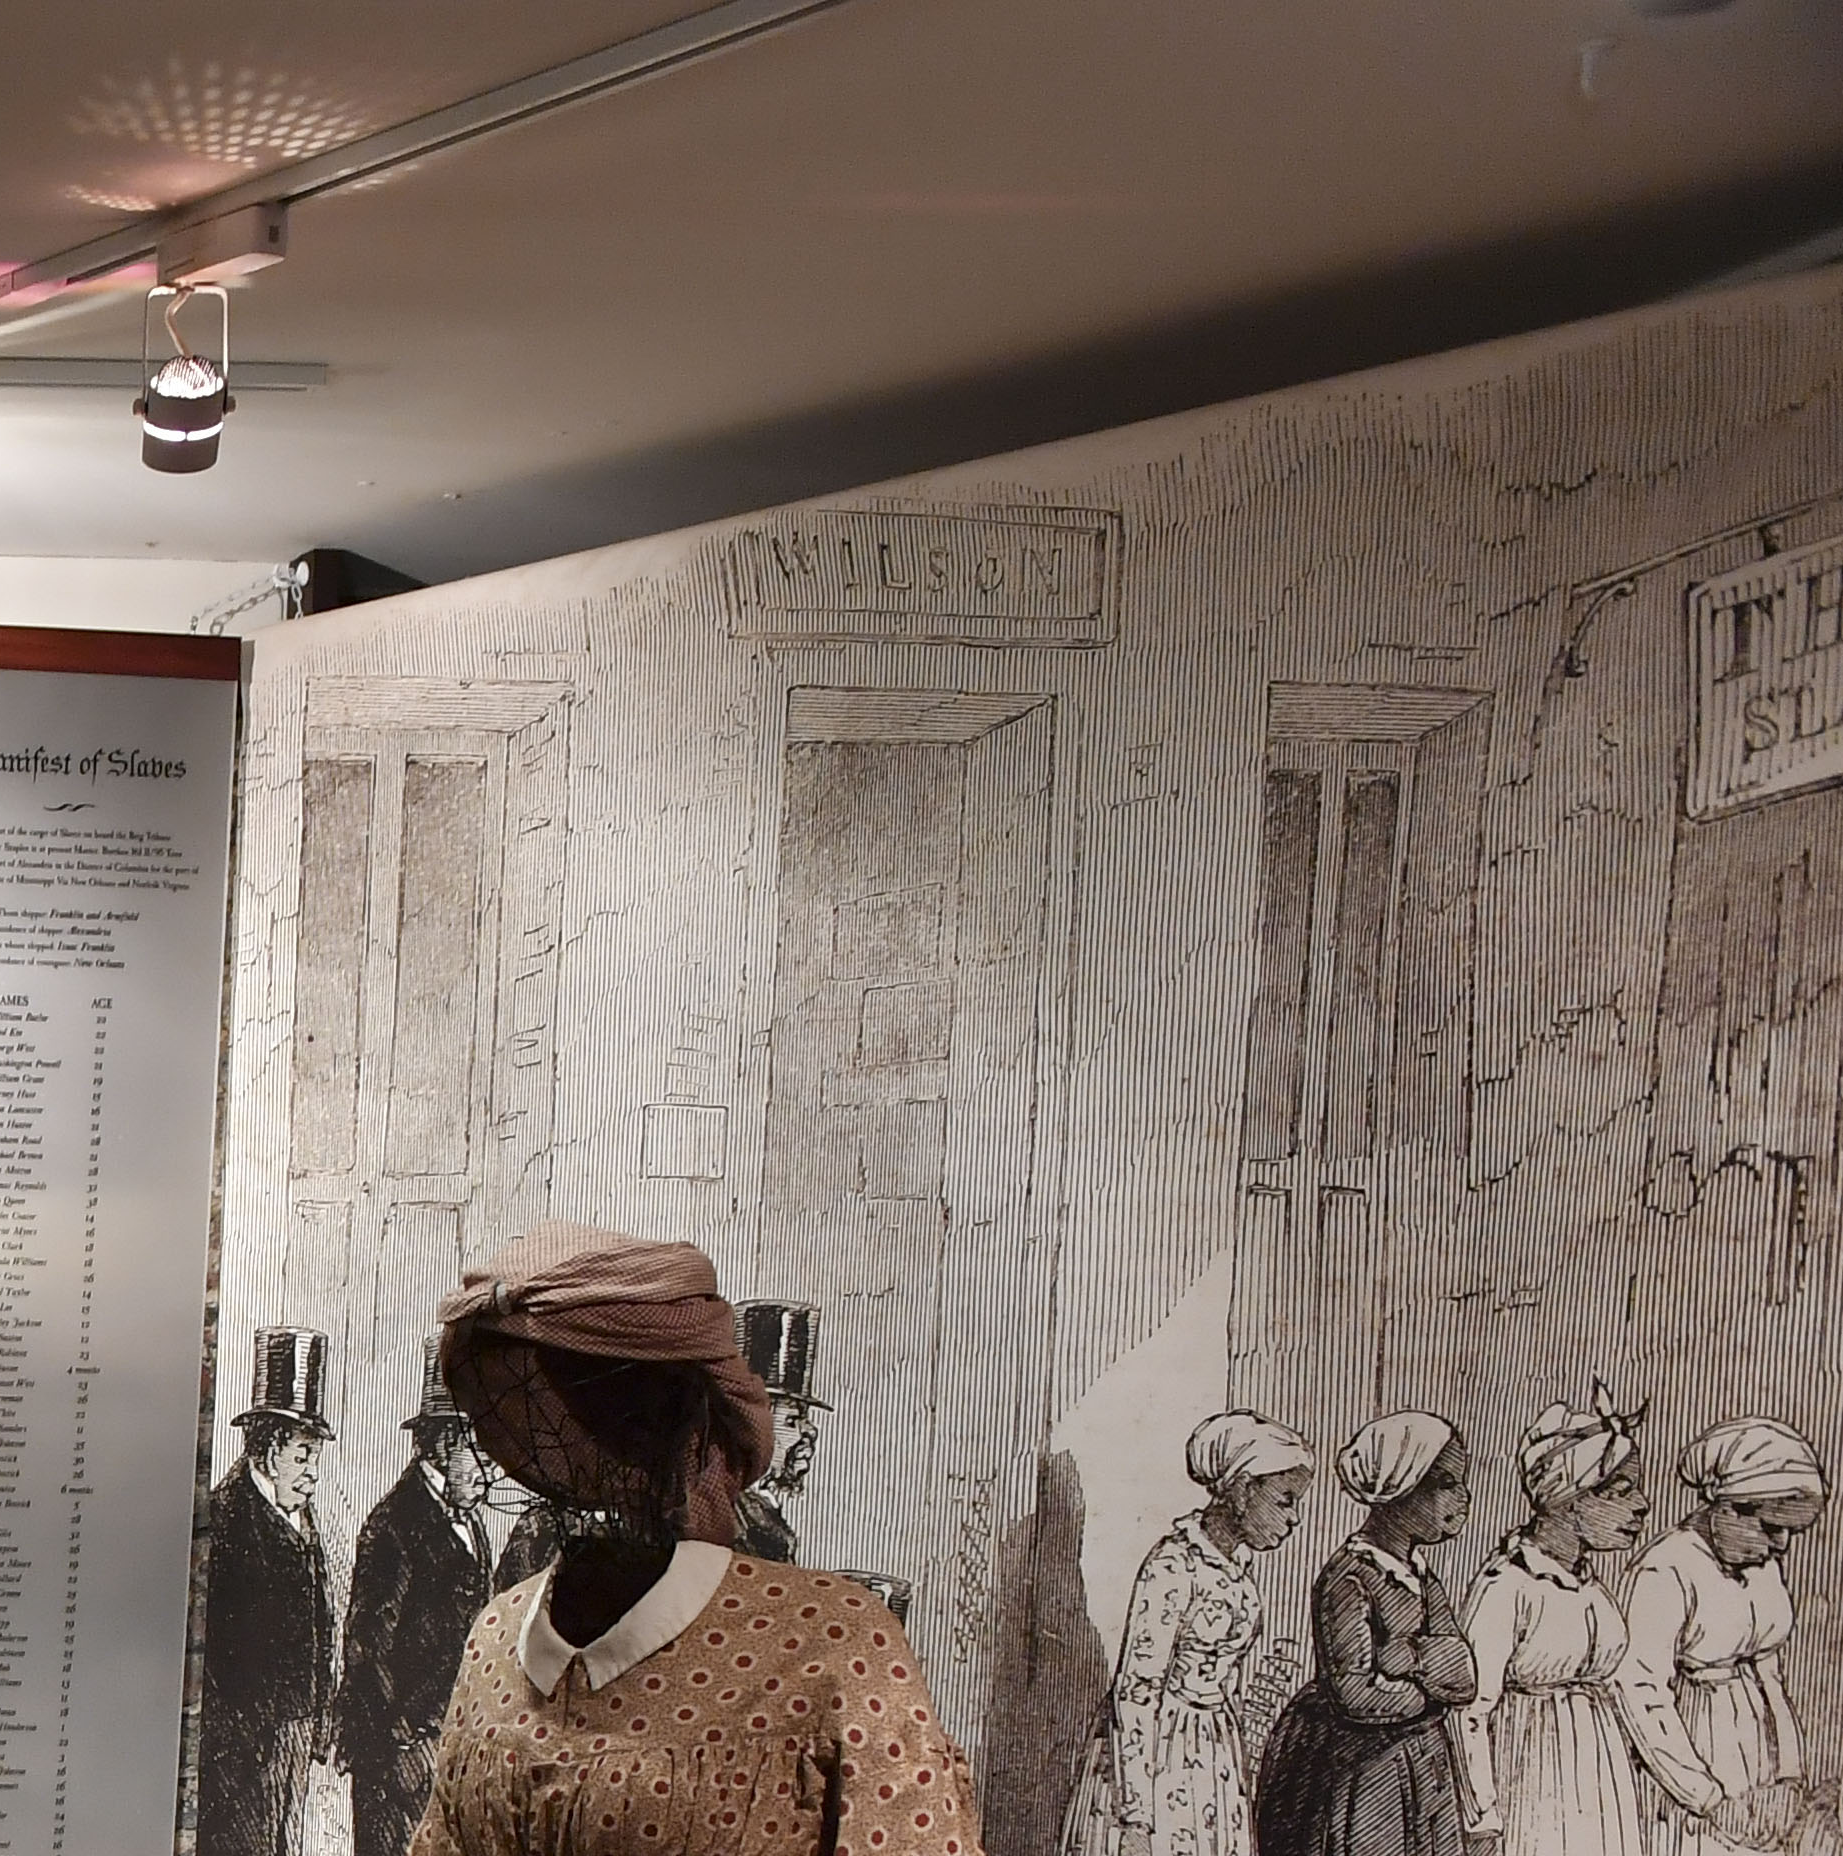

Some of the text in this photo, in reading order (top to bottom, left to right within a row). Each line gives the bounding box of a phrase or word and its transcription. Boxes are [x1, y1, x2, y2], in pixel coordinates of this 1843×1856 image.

[772, 531, 1063, 596] WILSON
[79, 747, 105, 786] of
[106, 748, 187, 779] Slaves
[91, 998, 112, 1009] AGE
